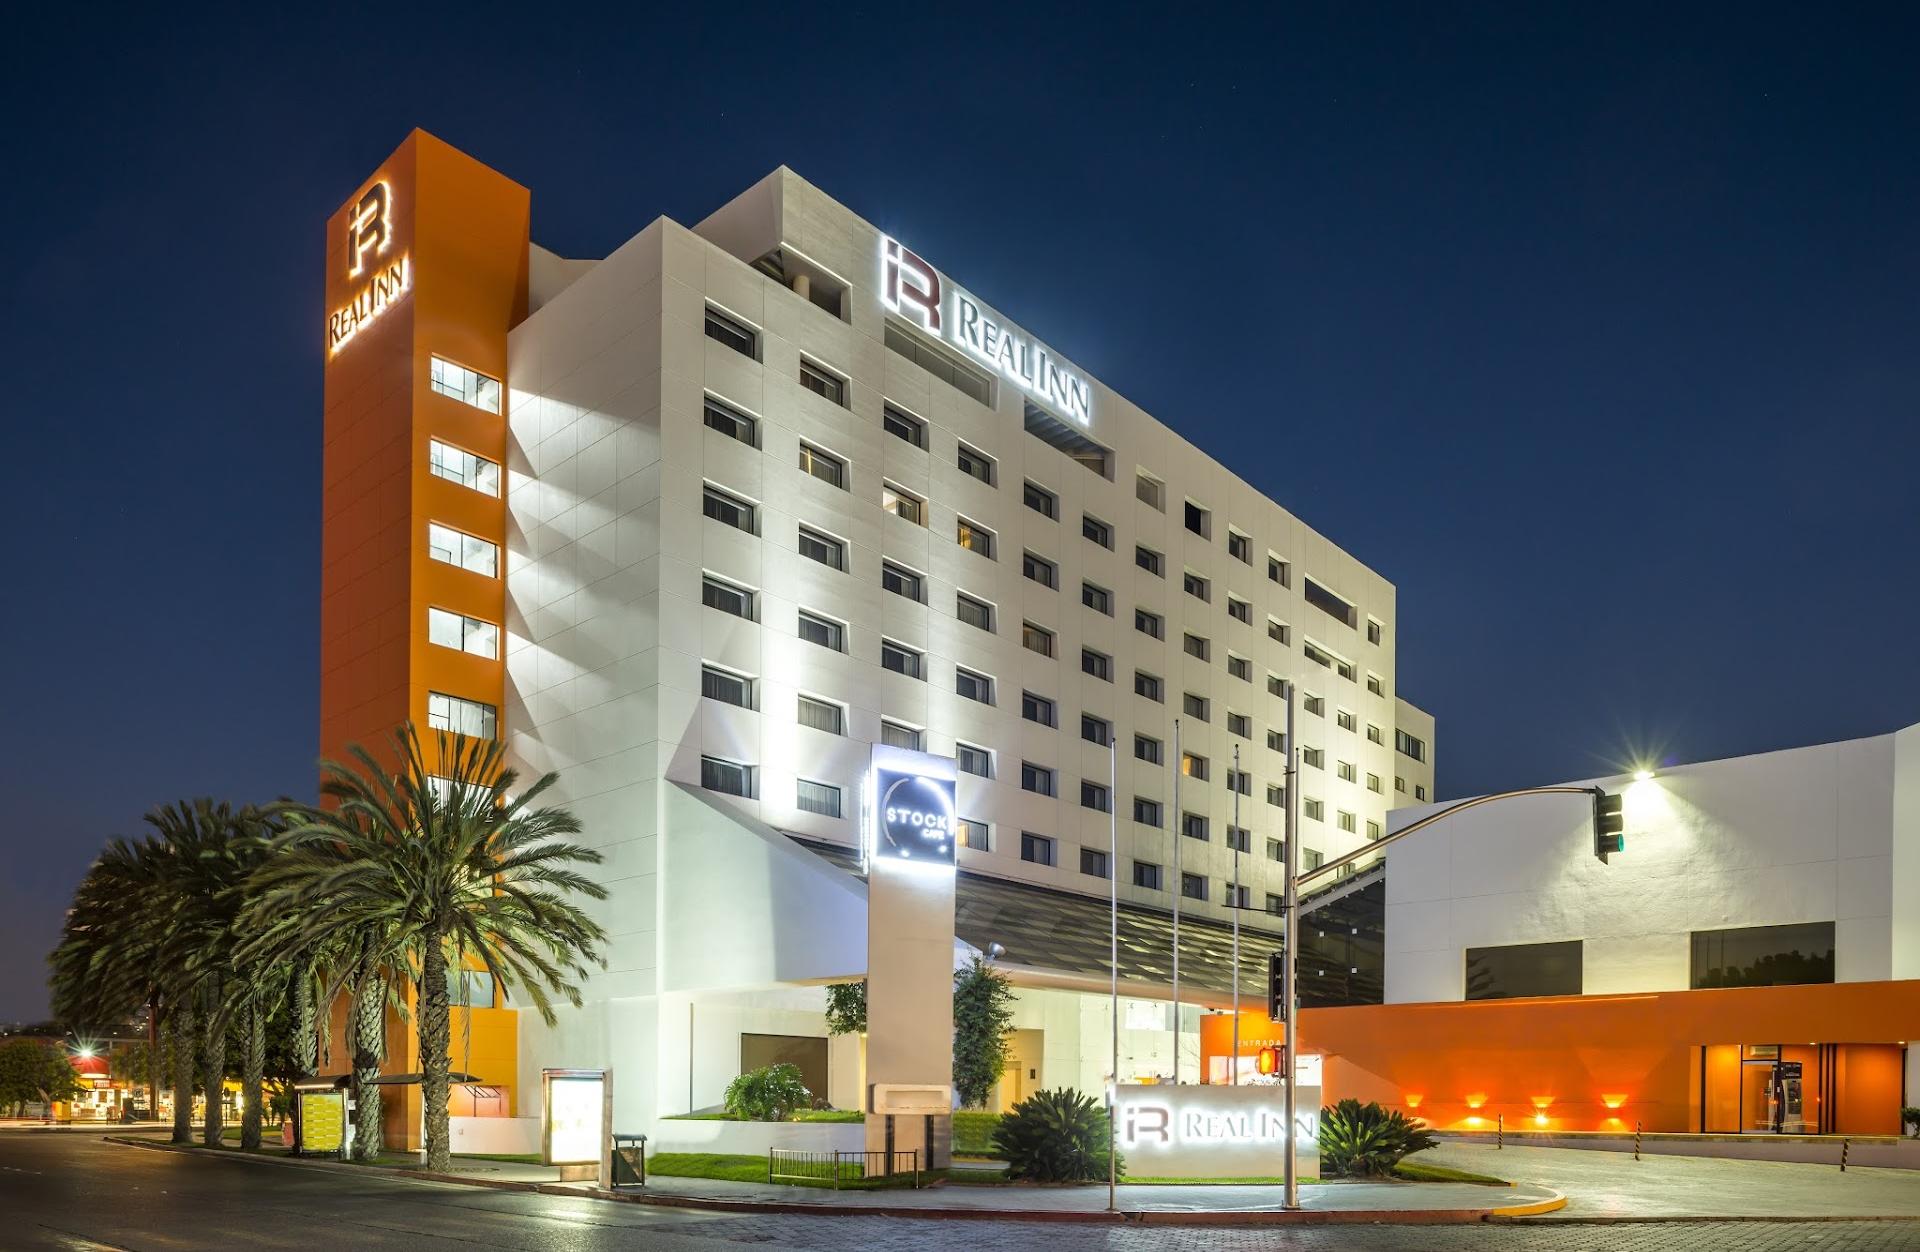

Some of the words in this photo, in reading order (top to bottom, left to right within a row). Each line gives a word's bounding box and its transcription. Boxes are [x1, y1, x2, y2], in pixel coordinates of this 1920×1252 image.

[329, 294, 367, 349] REAL
[370, 258, 403, 313] INN
[959, 295, 1032, 381] REAL
[1039, 350, 1089, 418] INN
[886, 807, 947, 829] STOCK
[1186, 1112, 1251, 1138] REAL
[1260, 1112, 1314, 1138] INN
